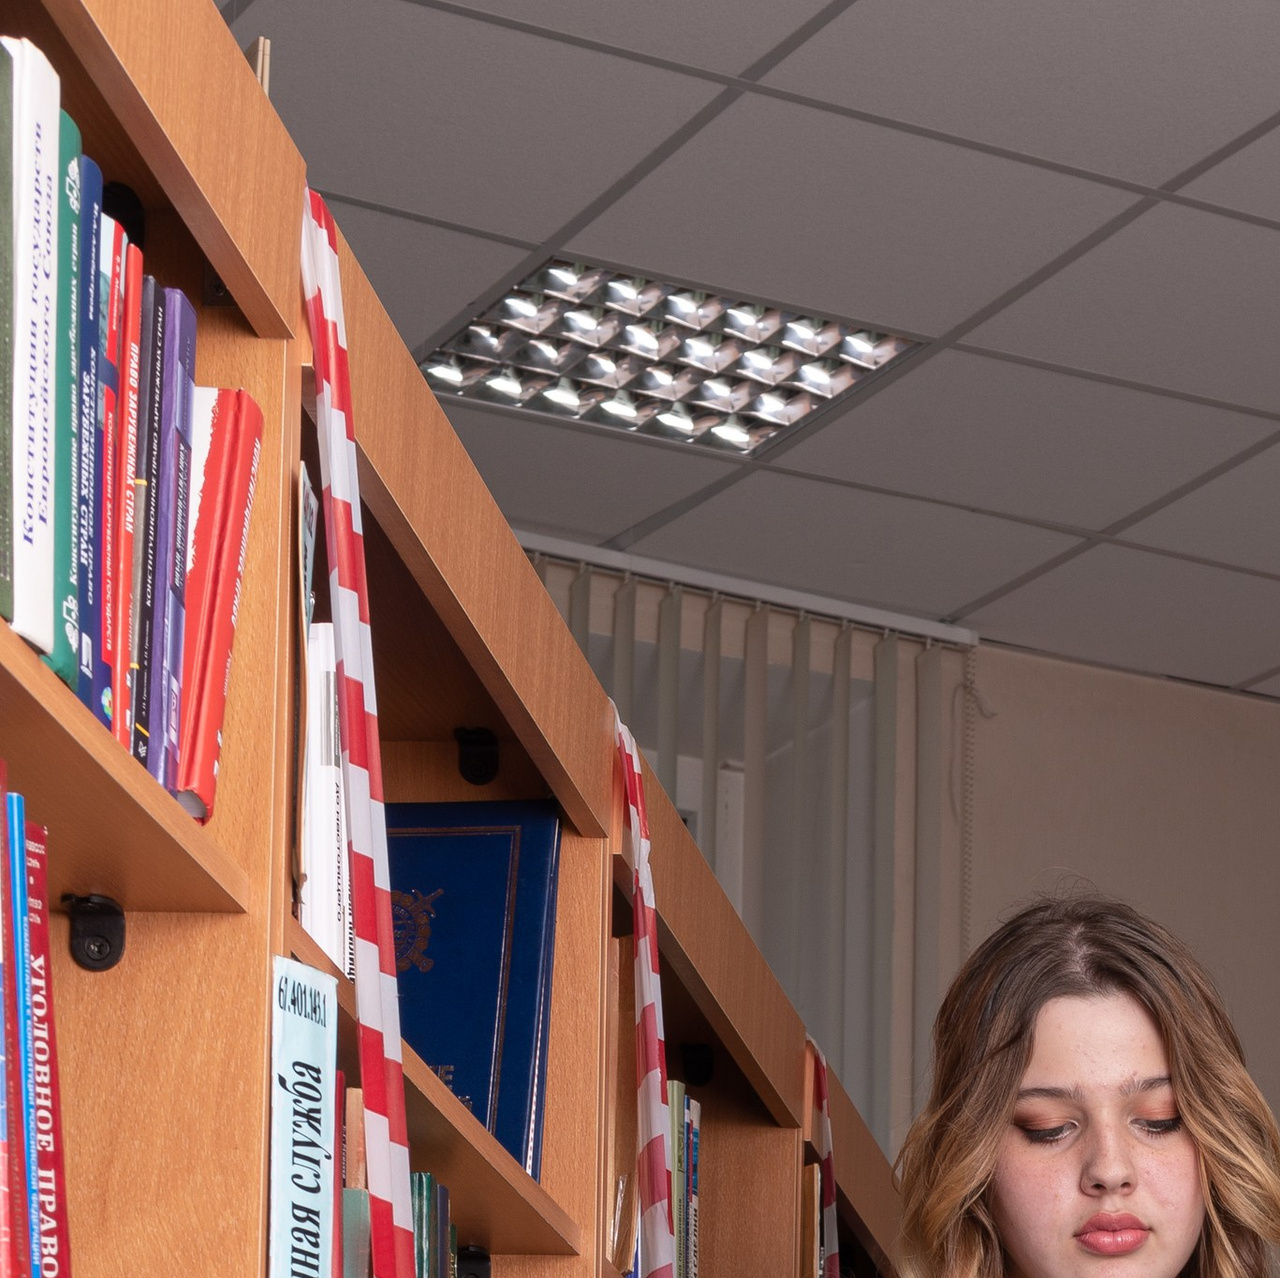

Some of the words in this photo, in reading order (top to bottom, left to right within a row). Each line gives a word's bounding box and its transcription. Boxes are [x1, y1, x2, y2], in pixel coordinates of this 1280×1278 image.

[30, 121, 42, 305] государств
[42, 173, 52, 281] Союза
[69, 277, 78, 378] зарубежных
[130, 342, 139, 388] ПРАВО
[156, 305, 164, 347] СТРАН
[23, 318, 38, 546] Конституции
[39, 295, 51, 526] Европейского
[80, 370, 89, 498] ЗАРУБЕЖНЫХ
[88, 346, 96, 539] КОНСТИТУЦИОННОЕ
[126, 391, 137, 488] ЗАРУБЕЖНЫХ
[152, 347, 162, 432] ЗАРУБЕЖНЫХ
[150, 431, 159, 475] ПРАВО
[69, 437, 78, 586] Конституционное
[80, 504, 88, 566] СТРАН
[125, 490, 135, 534] СТРАН
[146, 475, 157, 608] КОНСТИТУЦИОННОЕ
[237, 438, 261, 579] КОНСТИТУЦИОННОЕ
[231, 579, 242, 630] ПРАВО
[30, 954, 54, 1151] УГОЛОВНОЕ
[277, 1060, 332, 1194] служба
[39, 1168, 58, 1278] ПРАВО
